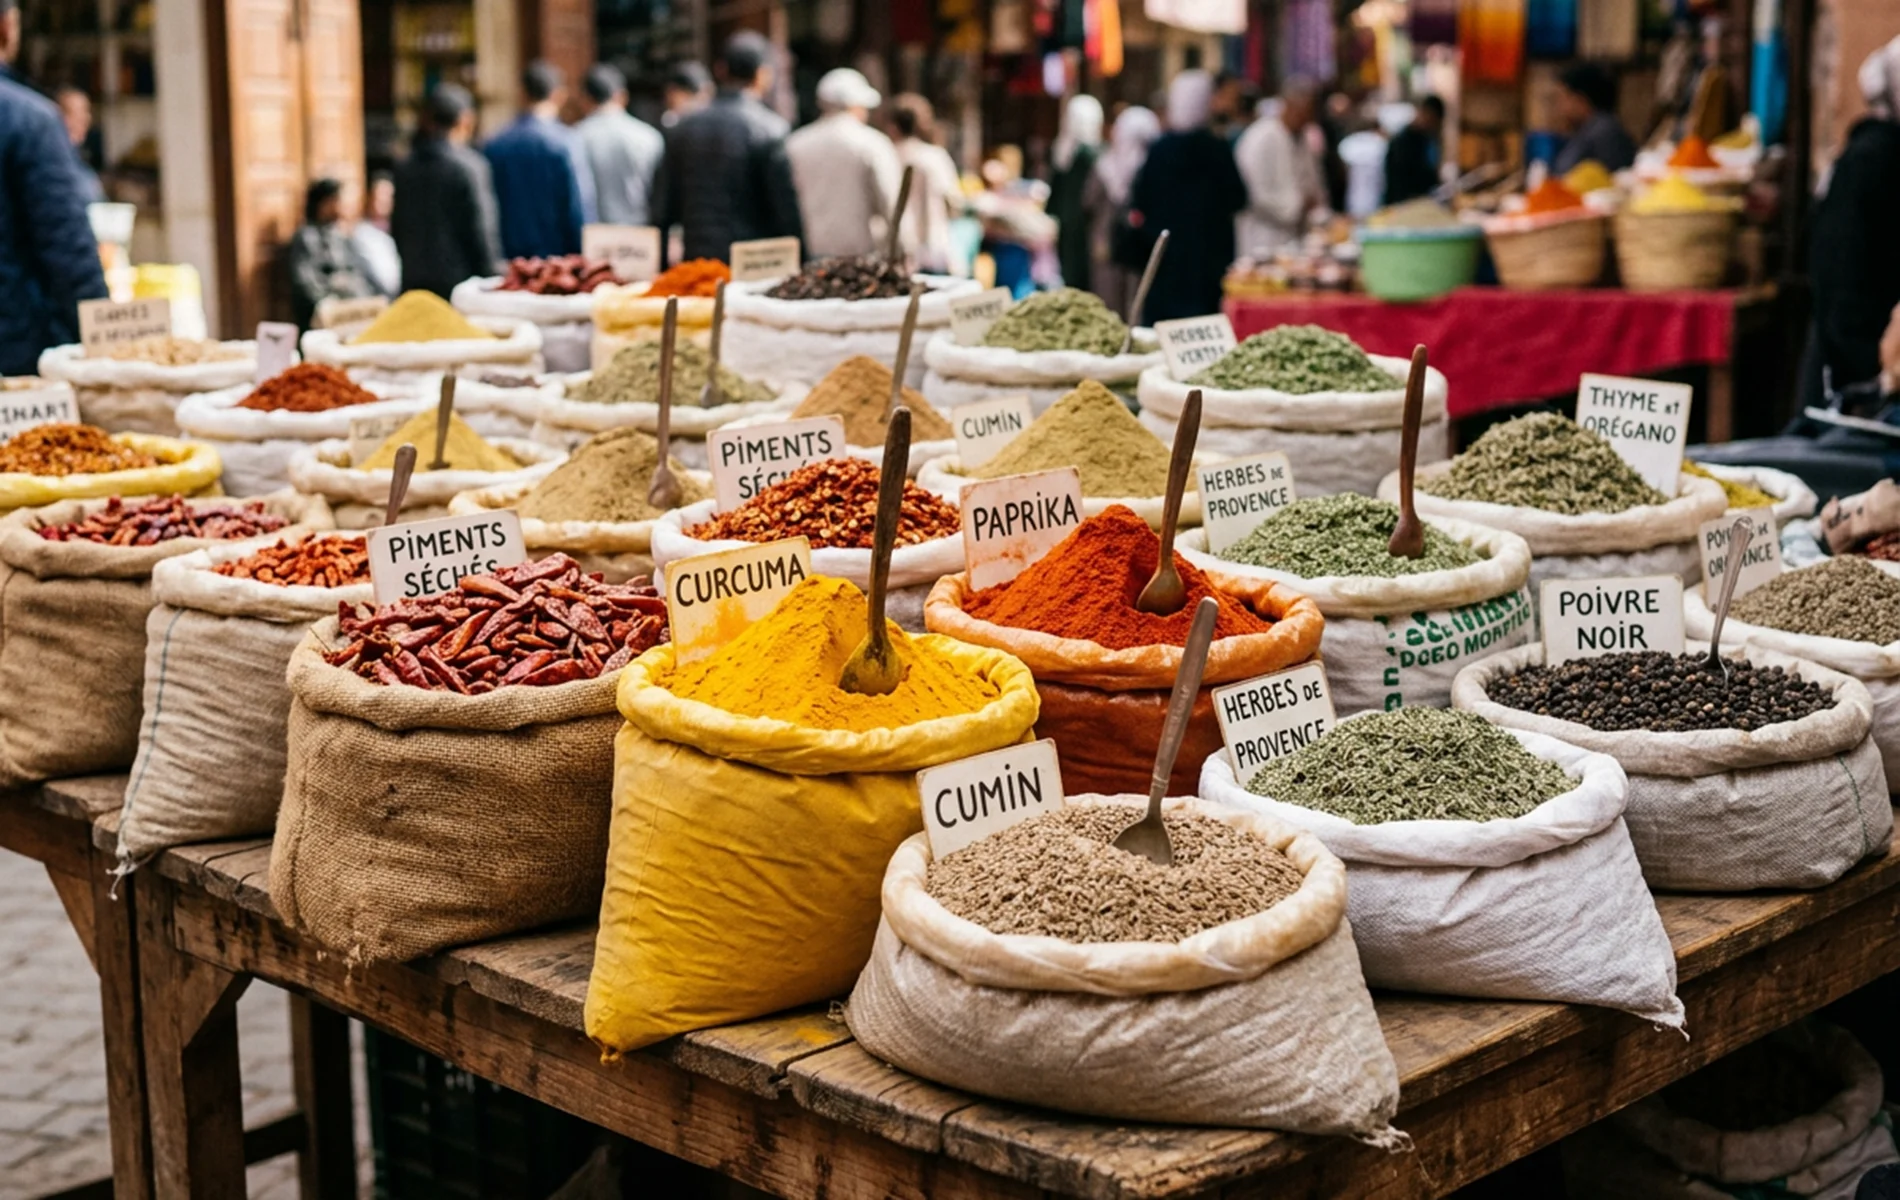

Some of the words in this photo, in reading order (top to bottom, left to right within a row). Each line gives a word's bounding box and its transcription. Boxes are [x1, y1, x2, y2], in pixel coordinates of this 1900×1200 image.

[1589, 386, 1659, 413] THYME
[1584, 415, 1677, 445] ORÉGANO
[1203, 463, 1266, 493] HERBES
[1208, 487, 1289, 520] PROVENCE
[676, 553, 806, 607] CURCUMA
[1223, 678, 1298, 723] HERBES
[1303, 681, 1323, 701] DE
